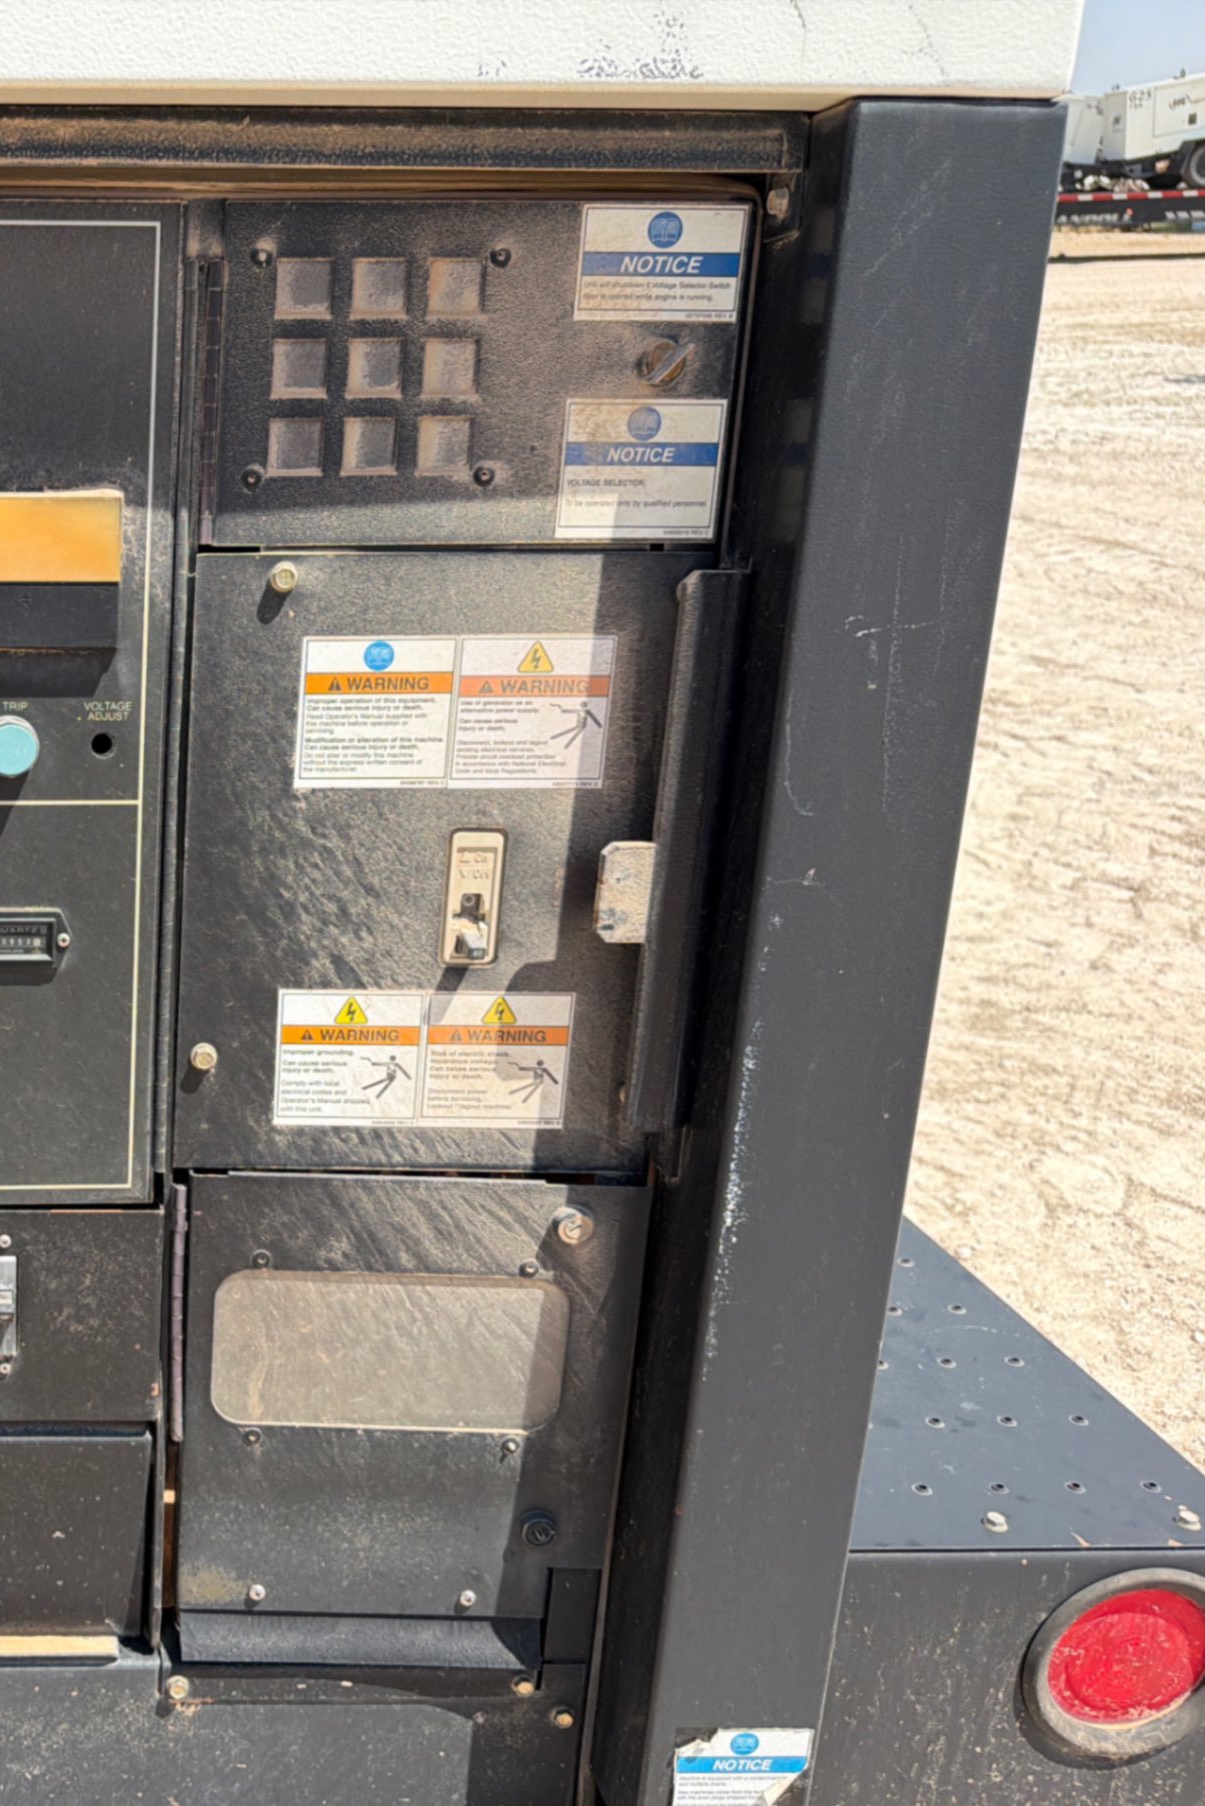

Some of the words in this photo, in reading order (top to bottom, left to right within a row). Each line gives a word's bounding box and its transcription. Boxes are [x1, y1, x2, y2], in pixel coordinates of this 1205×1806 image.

[619, 256, 703, 274] NOTICE
[606, 447, 675, 462] NOTICE
[567, 479, 601, 487] VOLTAGE
[346, 677, 429, 691] WARNING
[500, 680, 589, 693] WARNING
[3, 702, 27, 711] TRIP
[84, 702, 131, 711] VOLTAGE
[372, 705, 391, 713] injury
[88, 712, 128, 721] ADJUST
[320, 1030, 399, 1041] WARNING
[467, 1030, 546, 1043] WARNING
[713, 1759, 772, 1771] NOTICE
